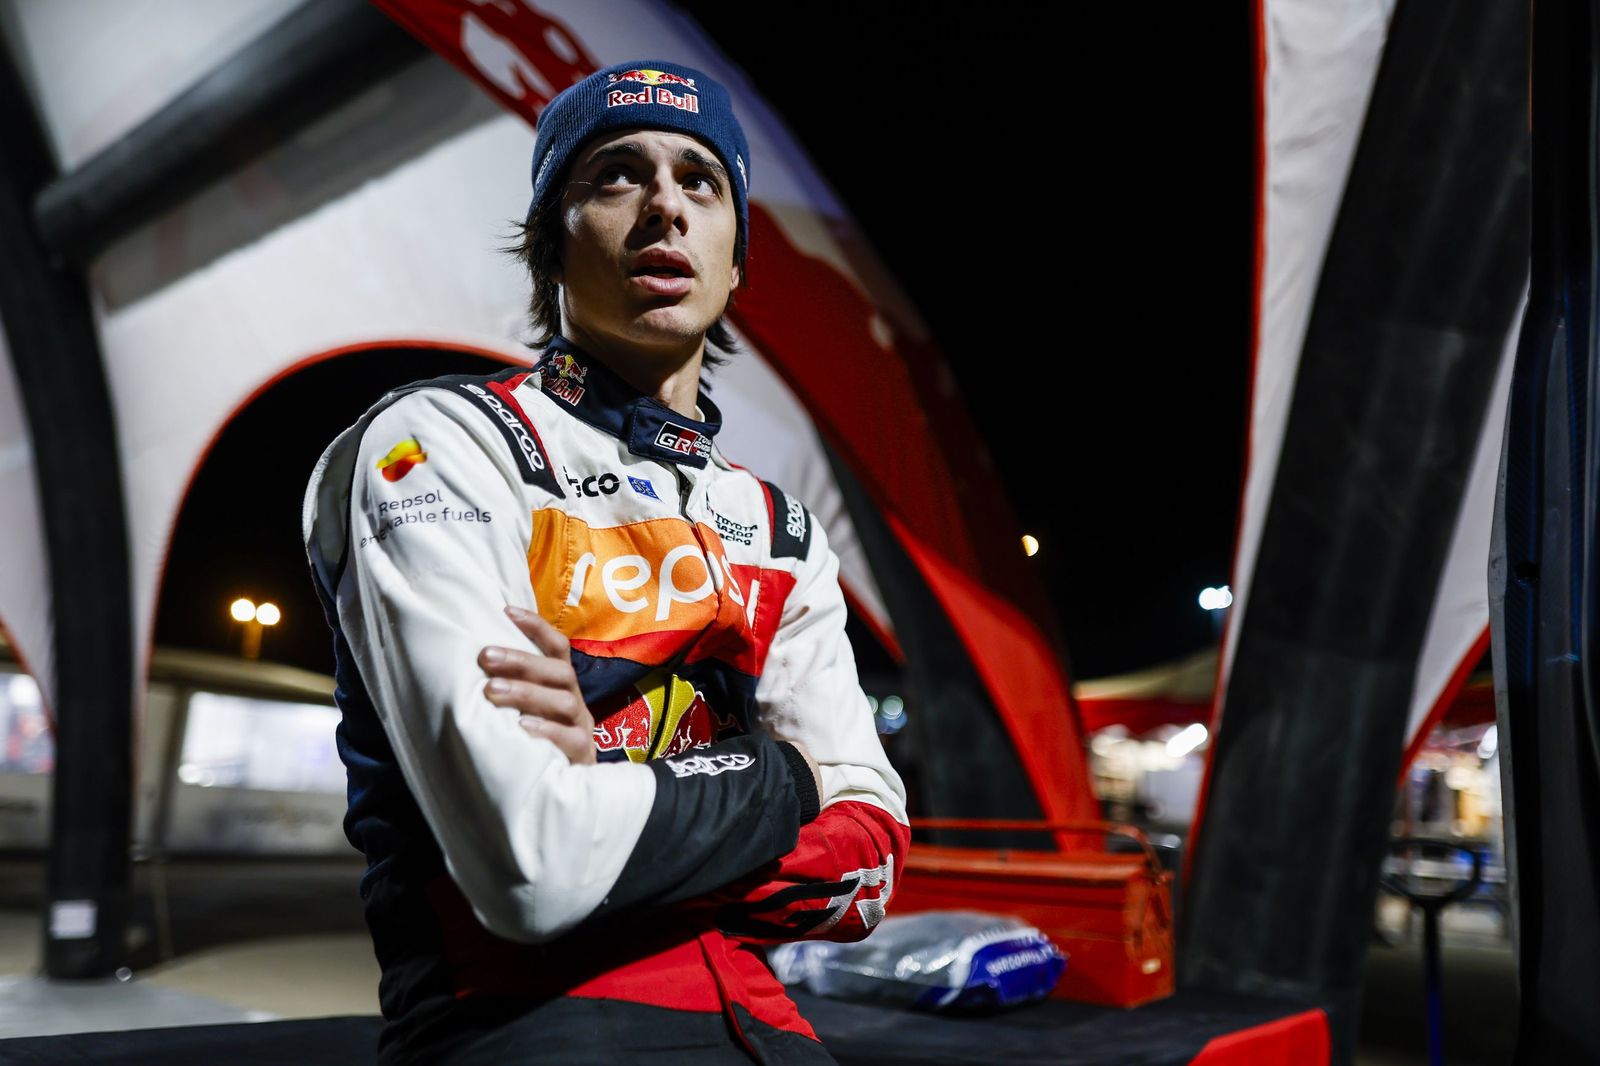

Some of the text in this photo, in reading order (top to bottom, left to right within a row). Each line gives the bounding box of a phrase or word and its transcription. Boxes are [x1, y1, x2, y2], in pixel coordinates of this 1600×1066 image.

[608, 86, 699, 113] Red Bull
[551, 377, 585, 406] Bull
[459, 383, 545, 472] sparco
[659, 432, 692, 452] GR
[379, 489, 443, 516] Repsol
[441, 507, 492, 523] fuels
[715, 513, 759, 531] TOYOTA
[719, 532, 752, 546] acing
[564, 544, 761, 630] repsl
